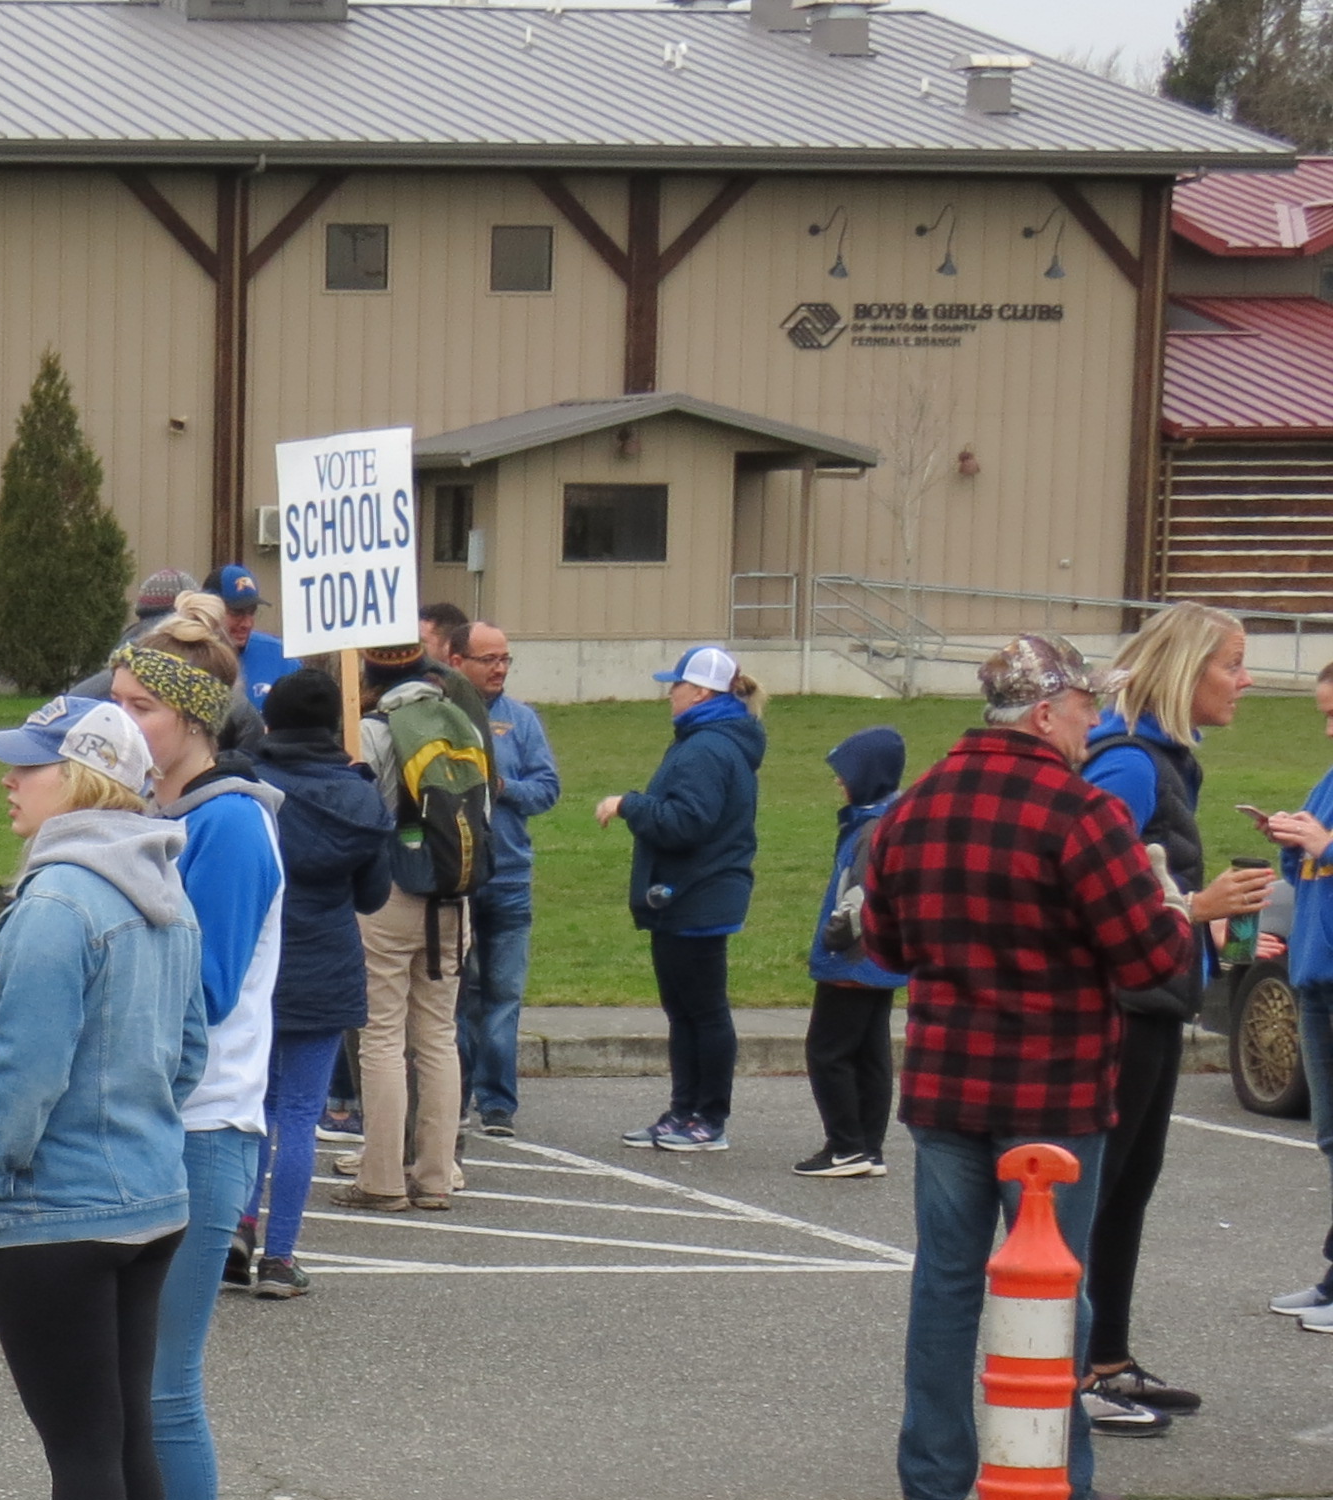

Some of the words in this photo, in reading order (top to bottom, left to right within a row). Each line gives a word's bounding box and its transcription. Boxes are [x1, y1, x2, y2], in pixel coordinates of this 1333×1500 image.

[853, 303, 908, 321] BOYS
[912, 303, 929, 321] &
[934, 304, 993, 321] GIRLS
[998, 304, 1064, 321] CLUBS
[850, 336, 911, 347] FERNDALE
[914, 336, 962, 347] BRANCH
[933, 323, 978, 333] COUNTY
[314, 448, 378, 492] VOTE
[285, 488, 410, 562] SCHOOLS
[299, 565, 401, 634] TODAY
